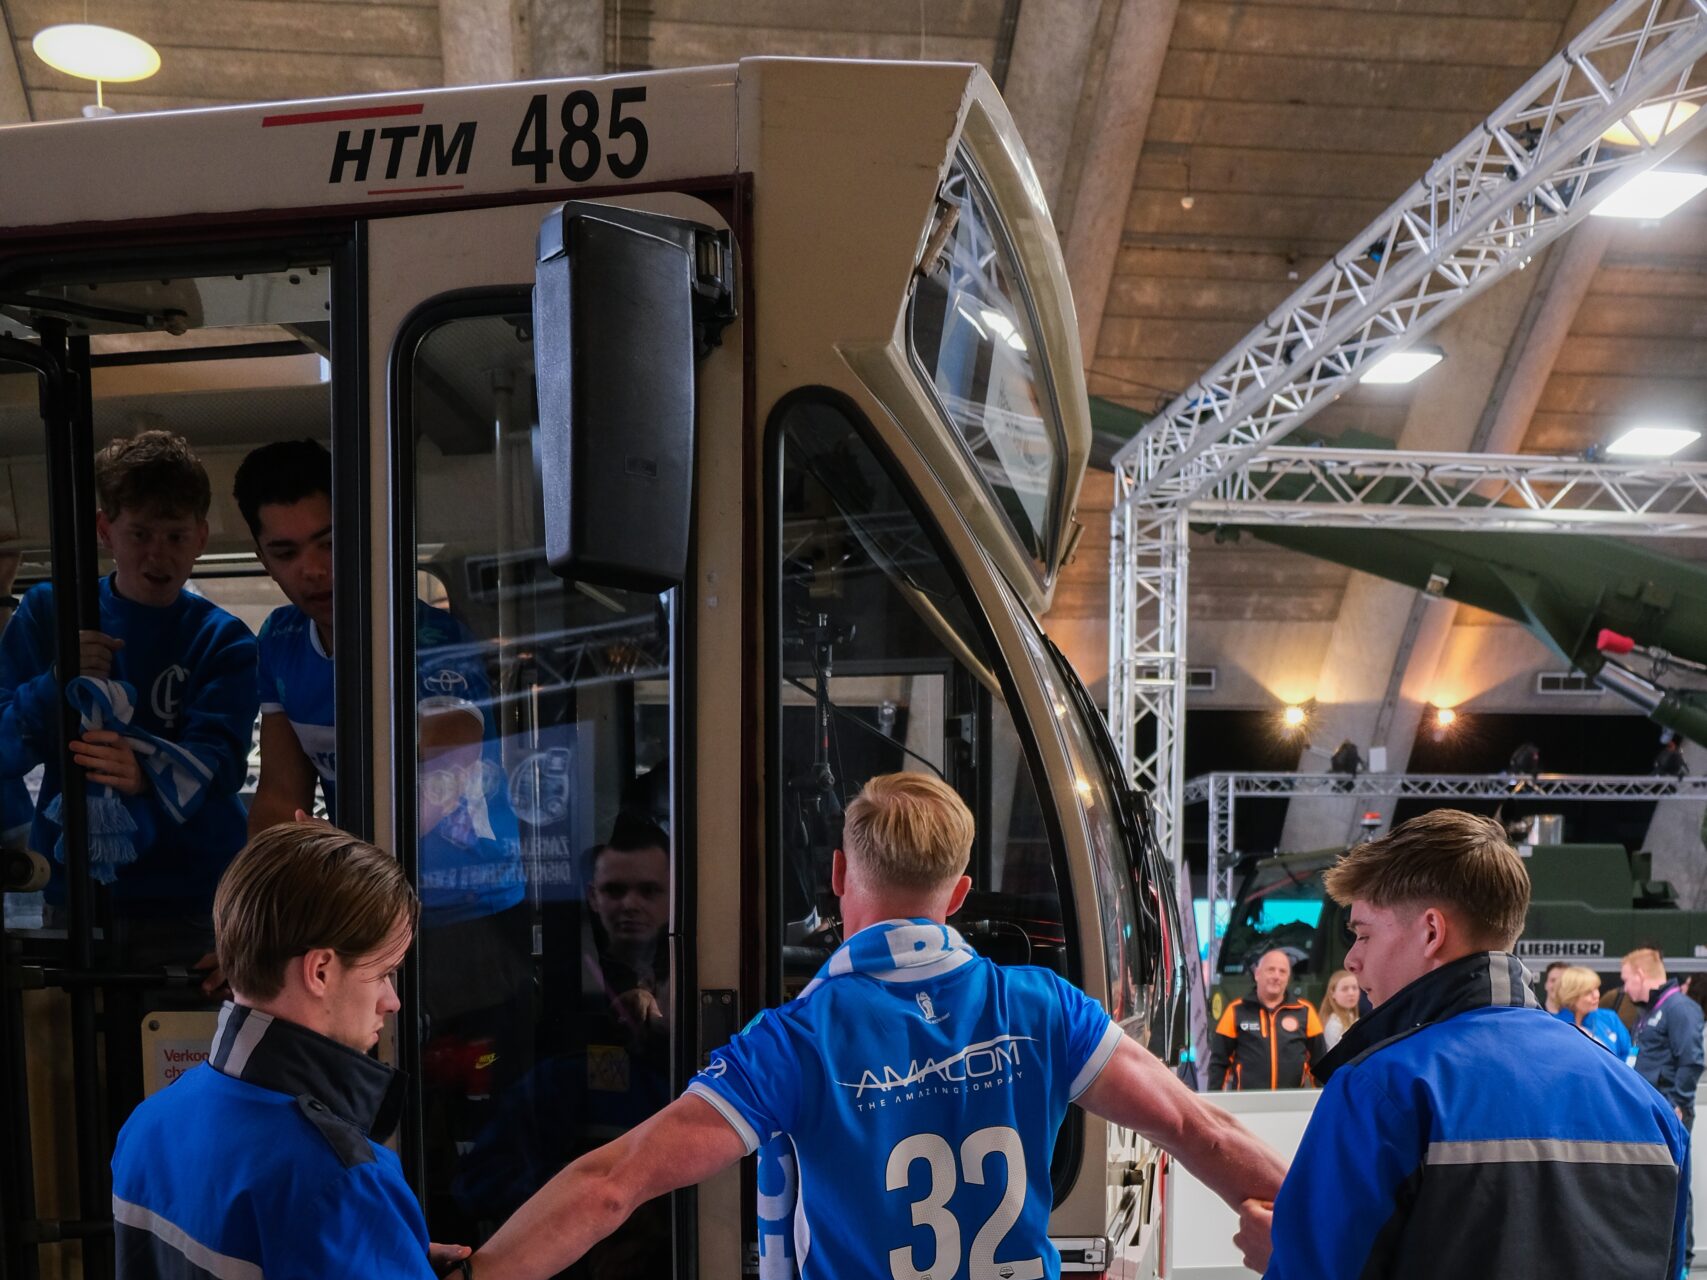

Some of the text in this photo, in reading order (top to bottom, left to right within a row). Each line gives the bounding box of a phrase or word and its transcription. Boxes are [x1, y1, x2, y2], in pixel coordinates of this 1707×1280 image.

[328, 86, 649, 184] HTM 485
[1519, 943, 1601, 956] LIEBHERR
[164, 1066, 186, 1079] ch
[856, 1041, 1021, 1099] AMACOM
[857, 1099, 887, 1113] THE
[895, 1087, 961, 1104] AMAZING
